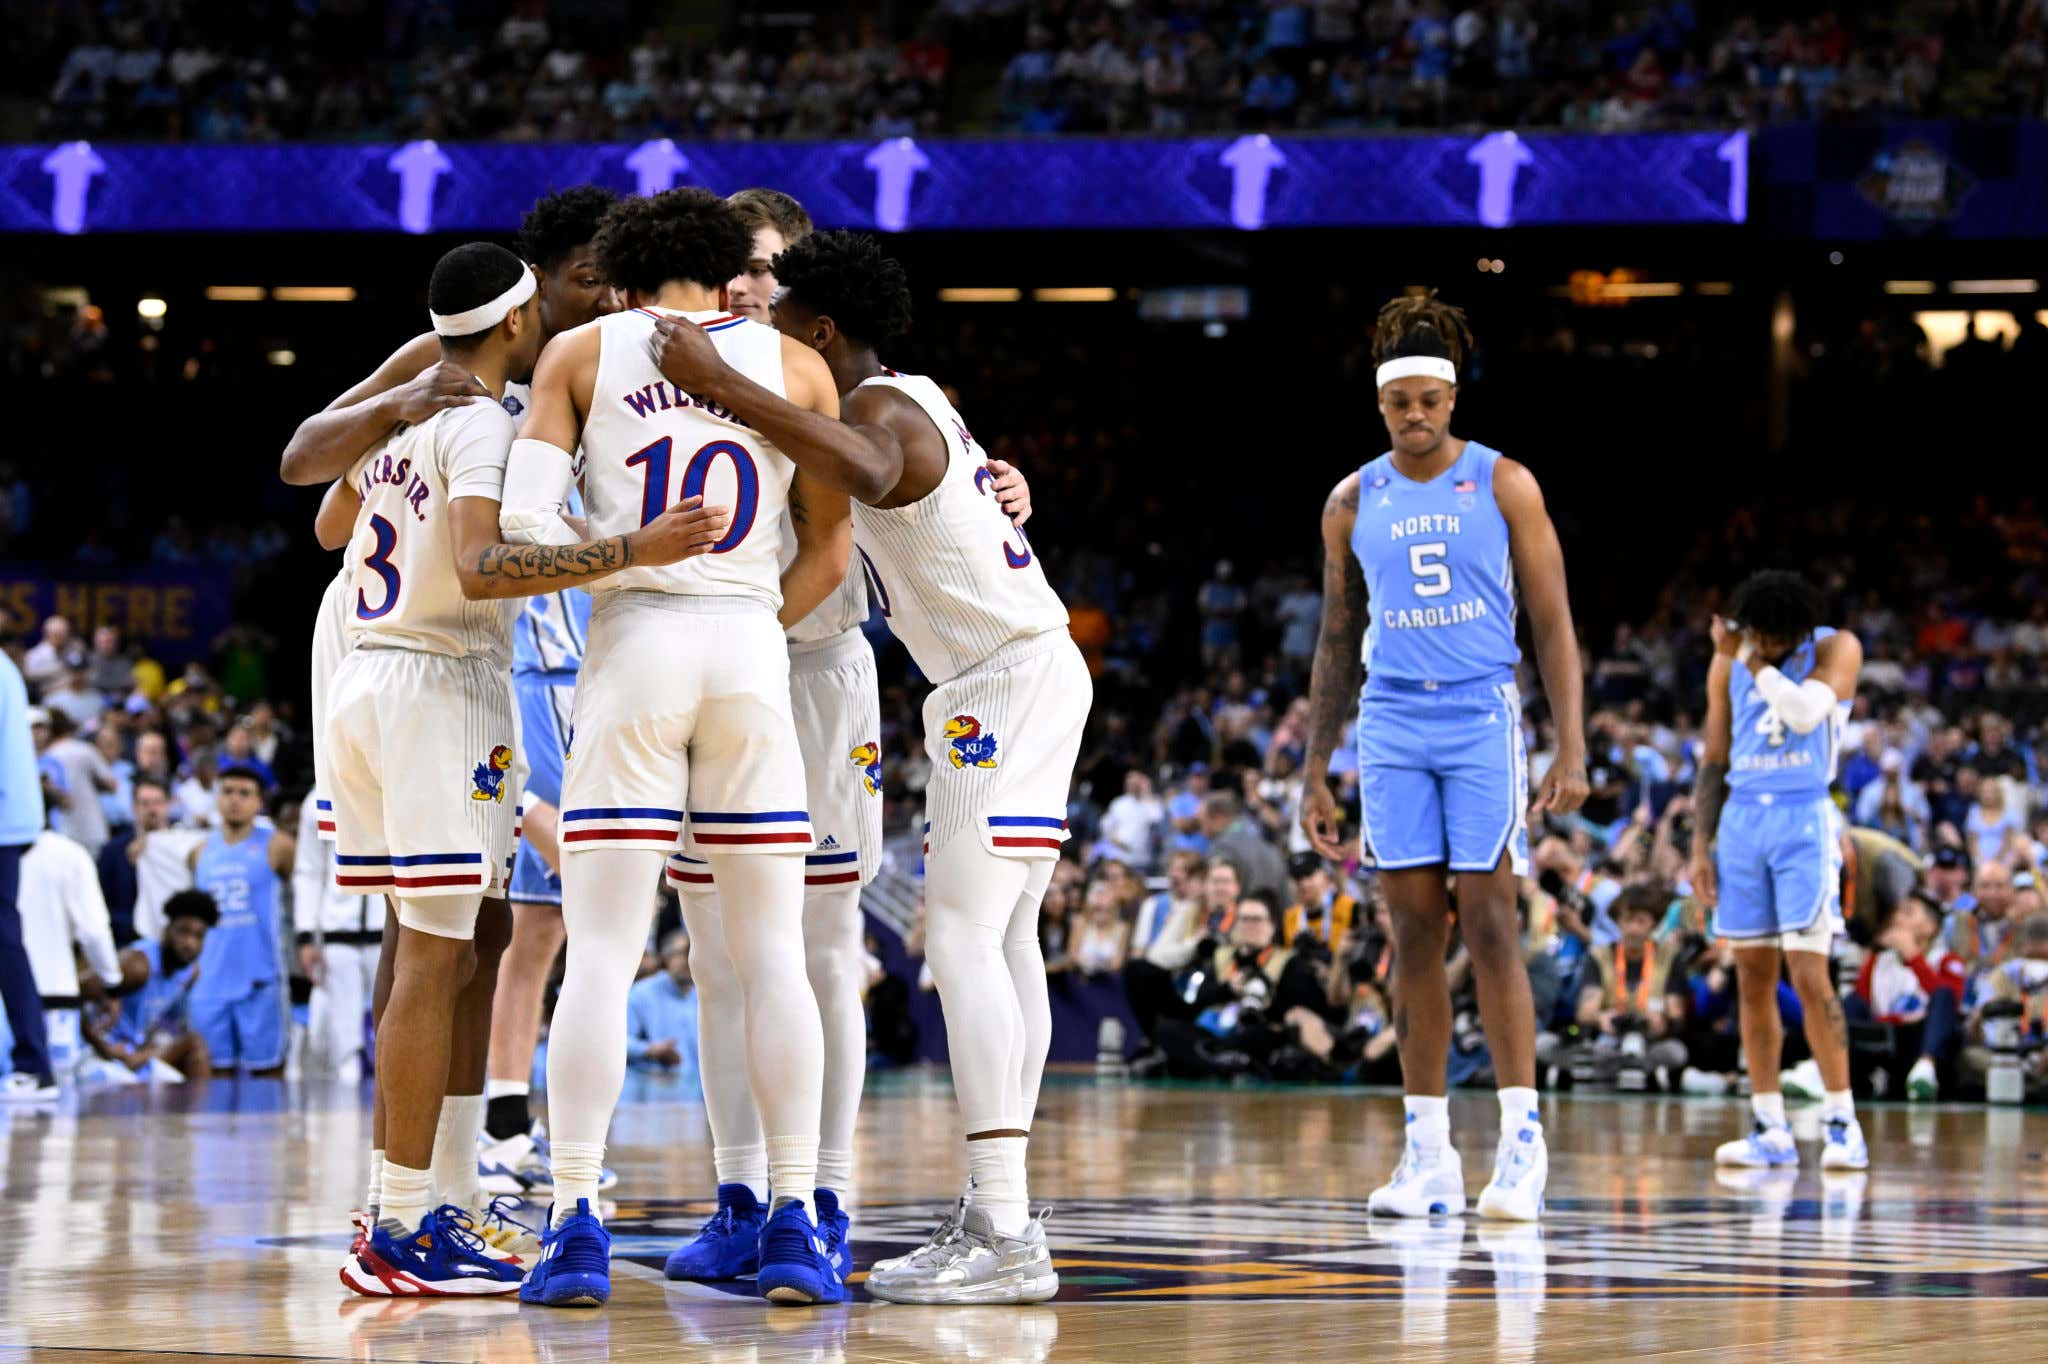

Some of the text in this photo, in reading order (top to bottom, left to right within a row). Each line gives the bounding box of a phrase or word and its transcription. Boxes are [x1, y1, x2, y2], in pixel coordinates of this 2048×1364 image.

[625, 435, 760, 555] 10
[1391, 514, 1461, 541] NORTH
[356, 513, 401, 621] 3
[1409, 541, 1452, 597] 5
[55, 583, 193, 638] HERE
[1384, 597, 1487, 629] CAROLINA
[965, 743, 983, 754] KU
